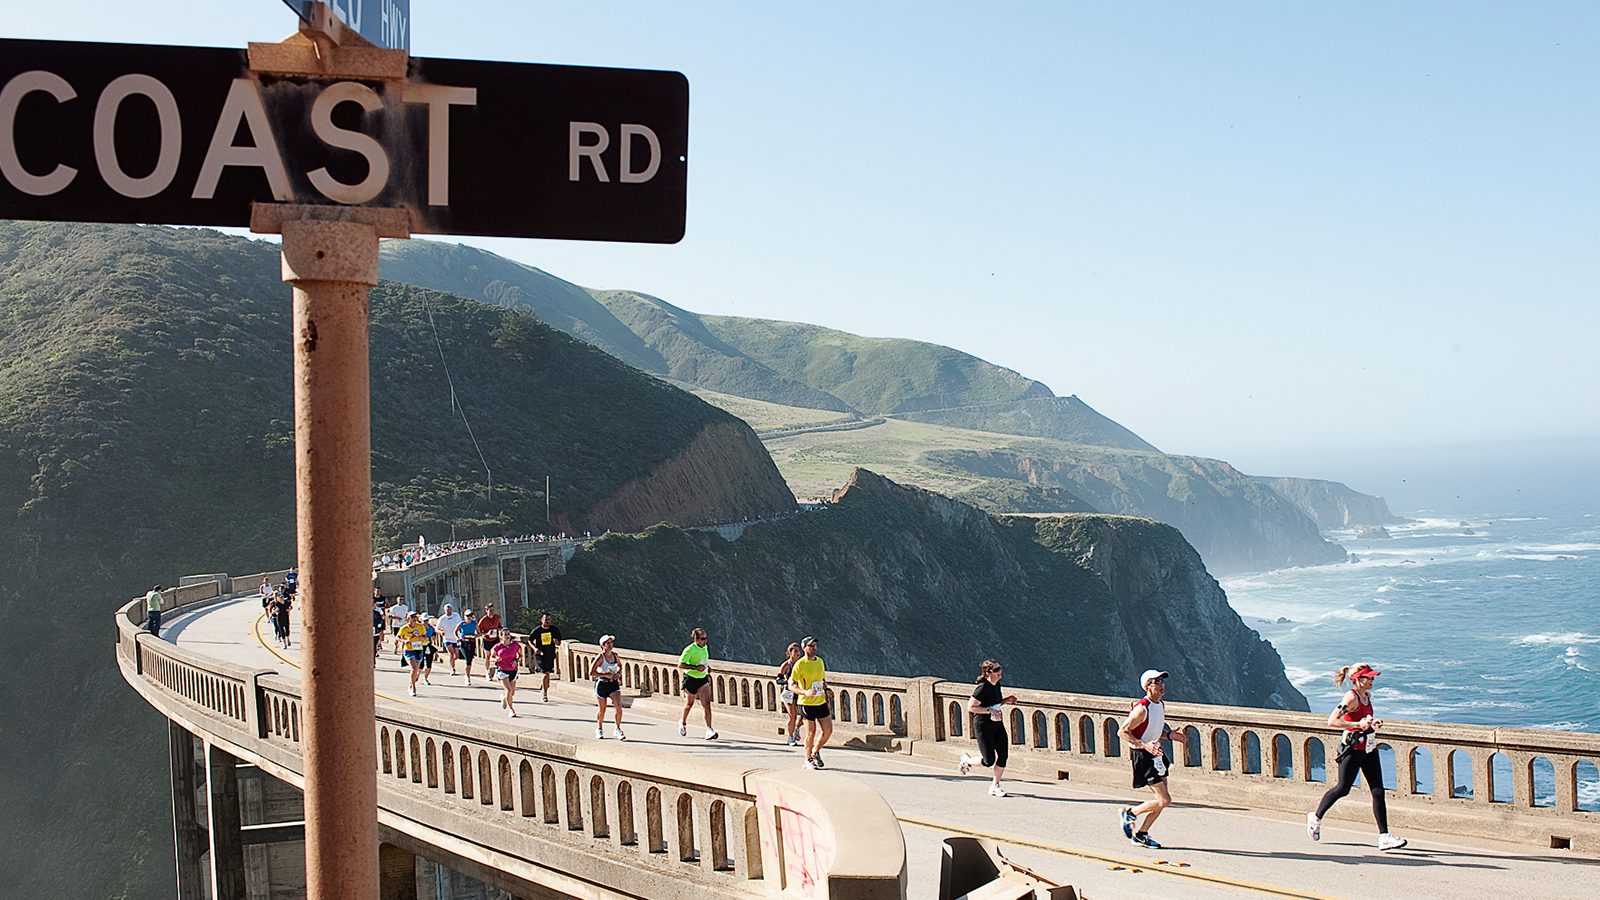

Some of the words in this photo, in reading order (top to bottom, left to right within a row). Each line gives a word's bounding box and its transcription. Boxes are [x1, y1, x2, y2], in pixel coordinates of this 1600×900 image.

[381, 0, 406, 50] HWY
[0, 70, 477, 206] COAST
[568, 121, 662, 184] RD
